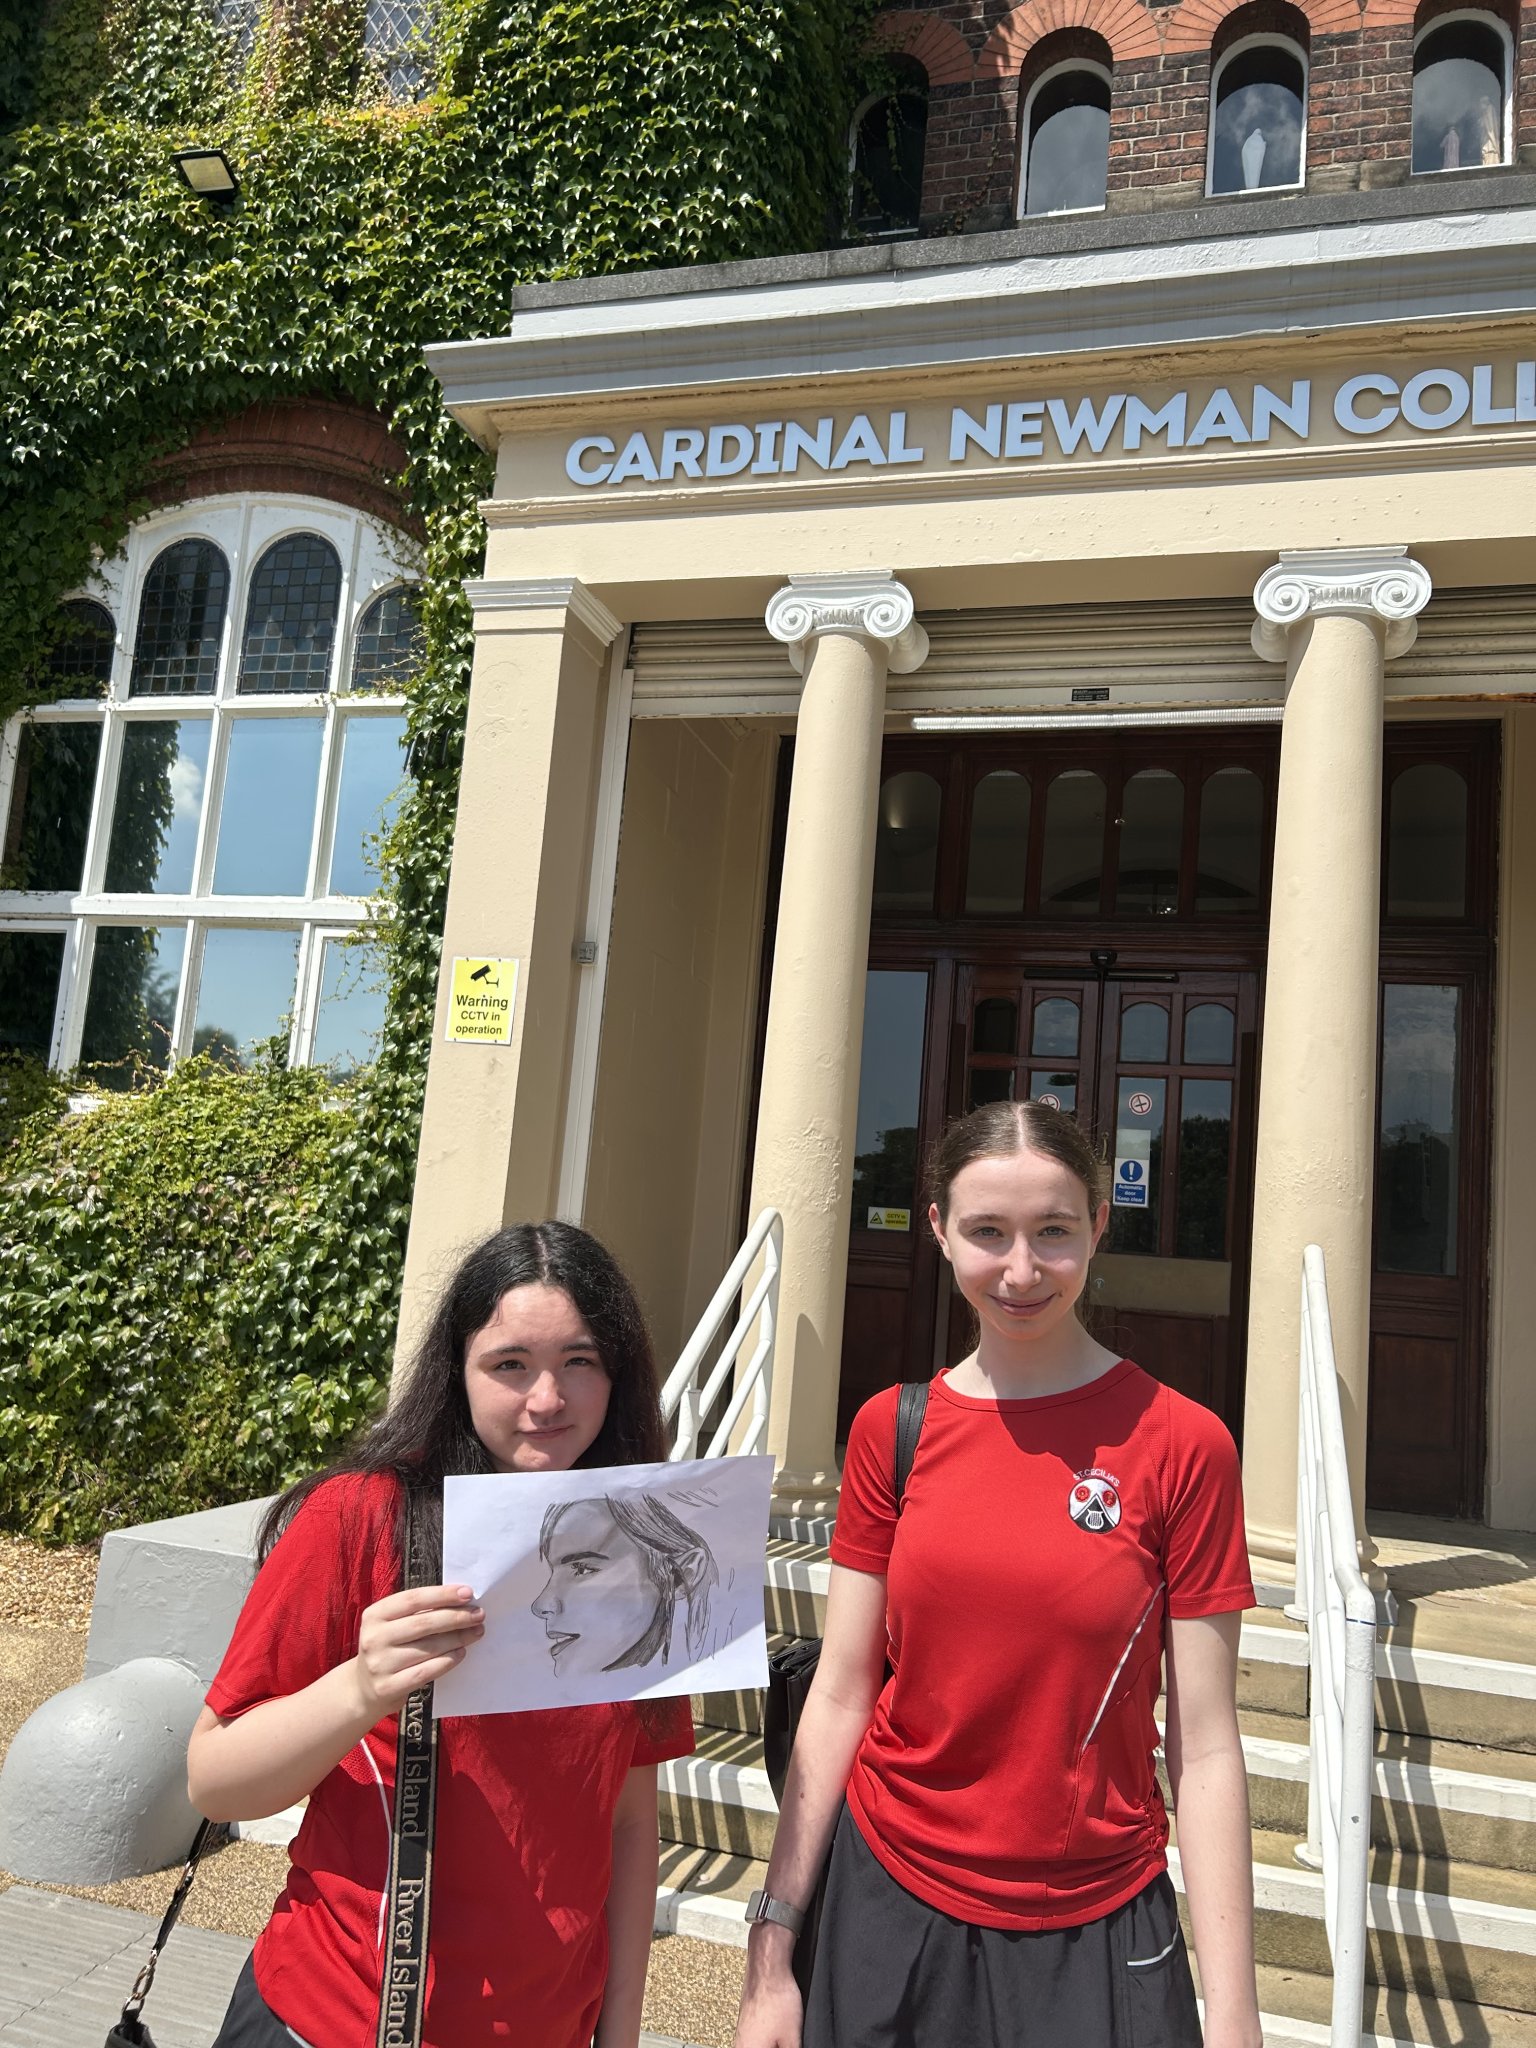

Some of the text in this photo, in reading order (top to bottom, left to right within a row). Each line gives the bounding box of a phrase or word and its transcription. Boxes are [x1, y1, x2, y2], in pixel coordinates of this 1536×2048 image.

[565, 411, 925, 486] CARDINAL
[948, 380, 1310, 461] NEWMAN
[456, 994, 509, 1011] Warning
[460, 1010, 501, 1021] CCTV in
[455, 1025, 503, 1035] operation
[401, 1753, 431, 1839] Island
[395, 1877, 425, 1954] River
